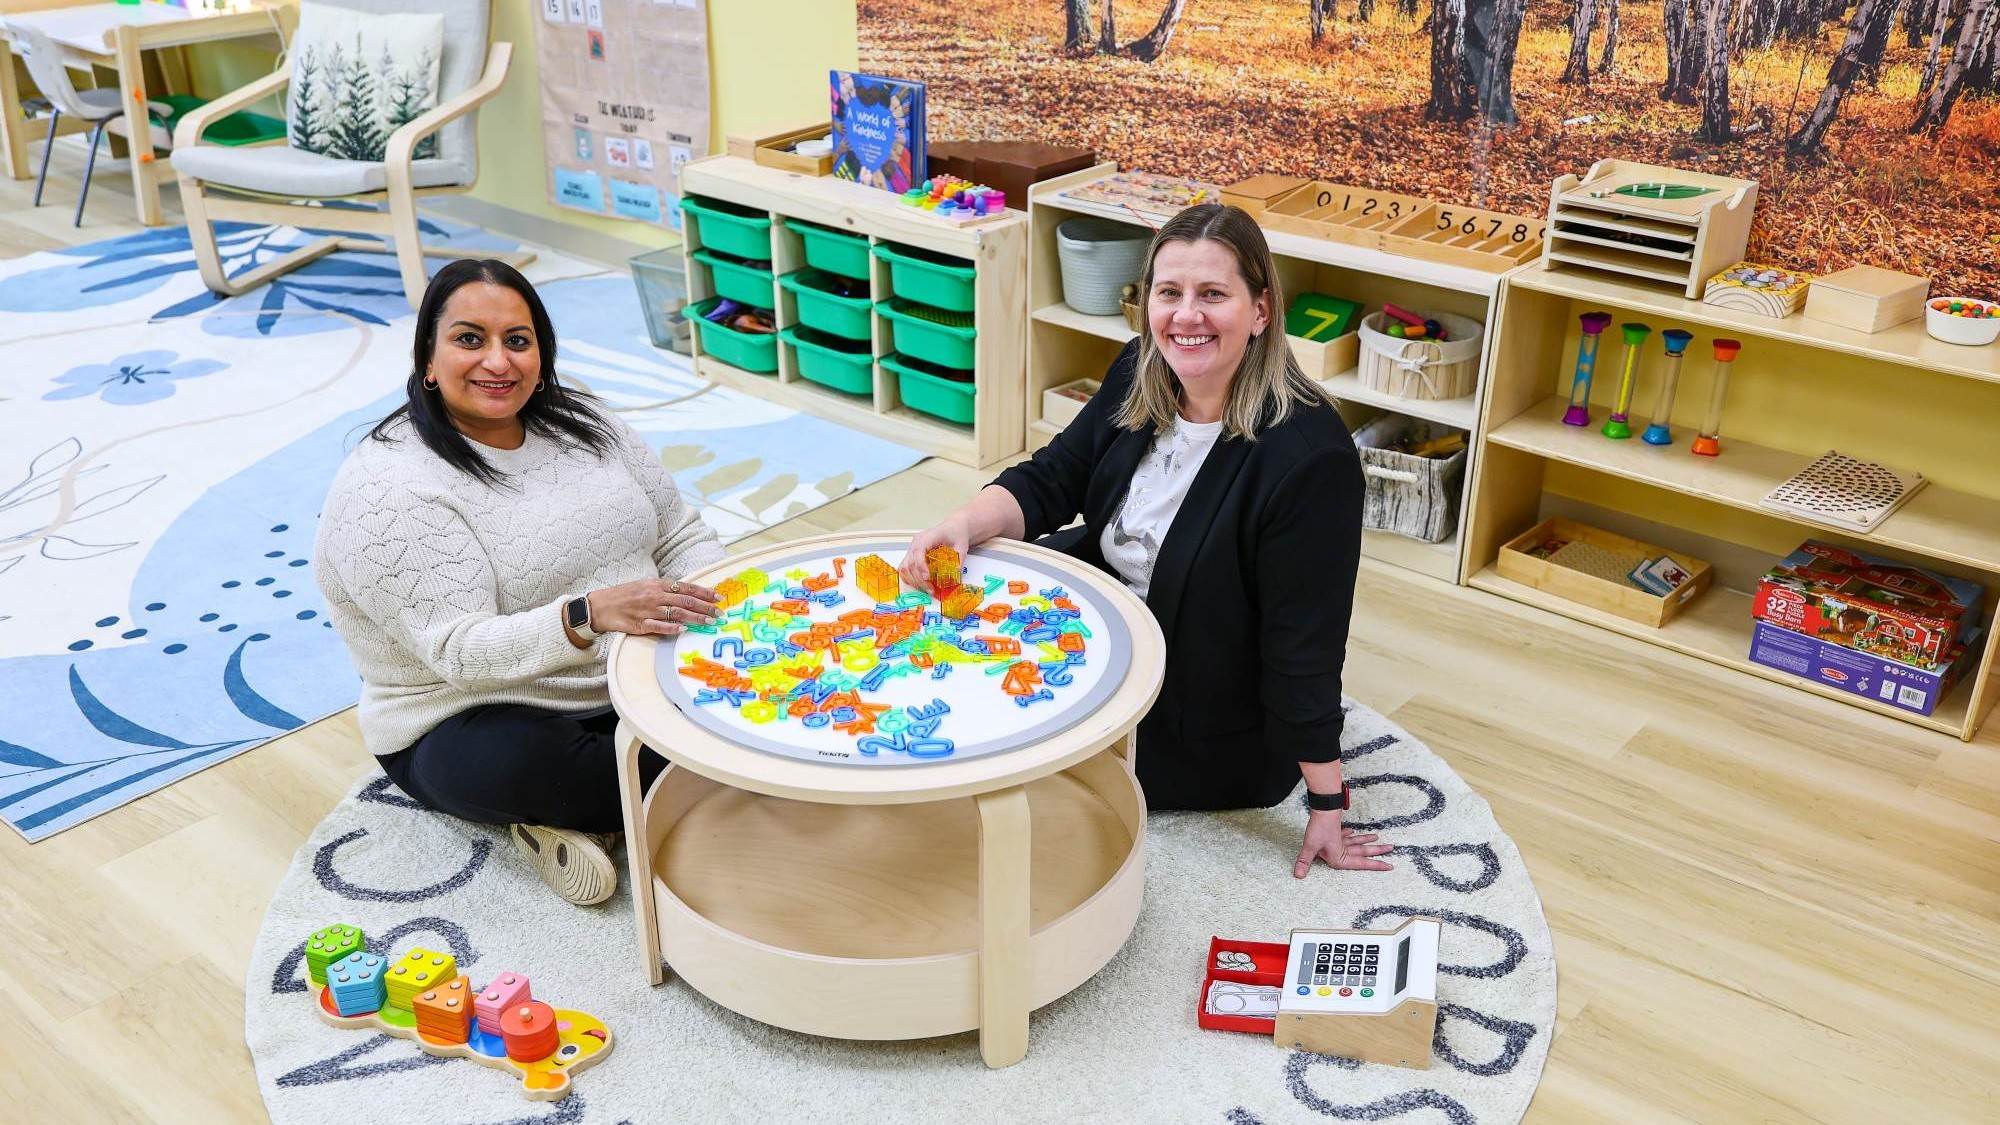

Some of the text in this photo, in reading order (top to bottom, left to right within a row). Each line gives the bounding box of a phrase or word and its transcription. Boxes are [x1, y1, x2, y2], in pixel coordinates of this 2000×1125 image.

[611, 104, 646, 121] WEATHER
[847, 107, 891, 128] A World of
[853, 122, 887, 141] Kindness
[1343, 194, 1351, 211] 1
[1362, 199, 1377, 215] 2
[1387, 201, 1400, 219] 3
[1437, 211, 1453, 230] 5
[1462, 216, 1477, 234] 6
[1487, 219, 1503, 237] 7
[1512, 223, 1528, 242] 8
[1302, 308, 1340, 341] 7
[1766, 596, 1788, 613] 32
[1767, 609, 1802, 624] Busy Barn
